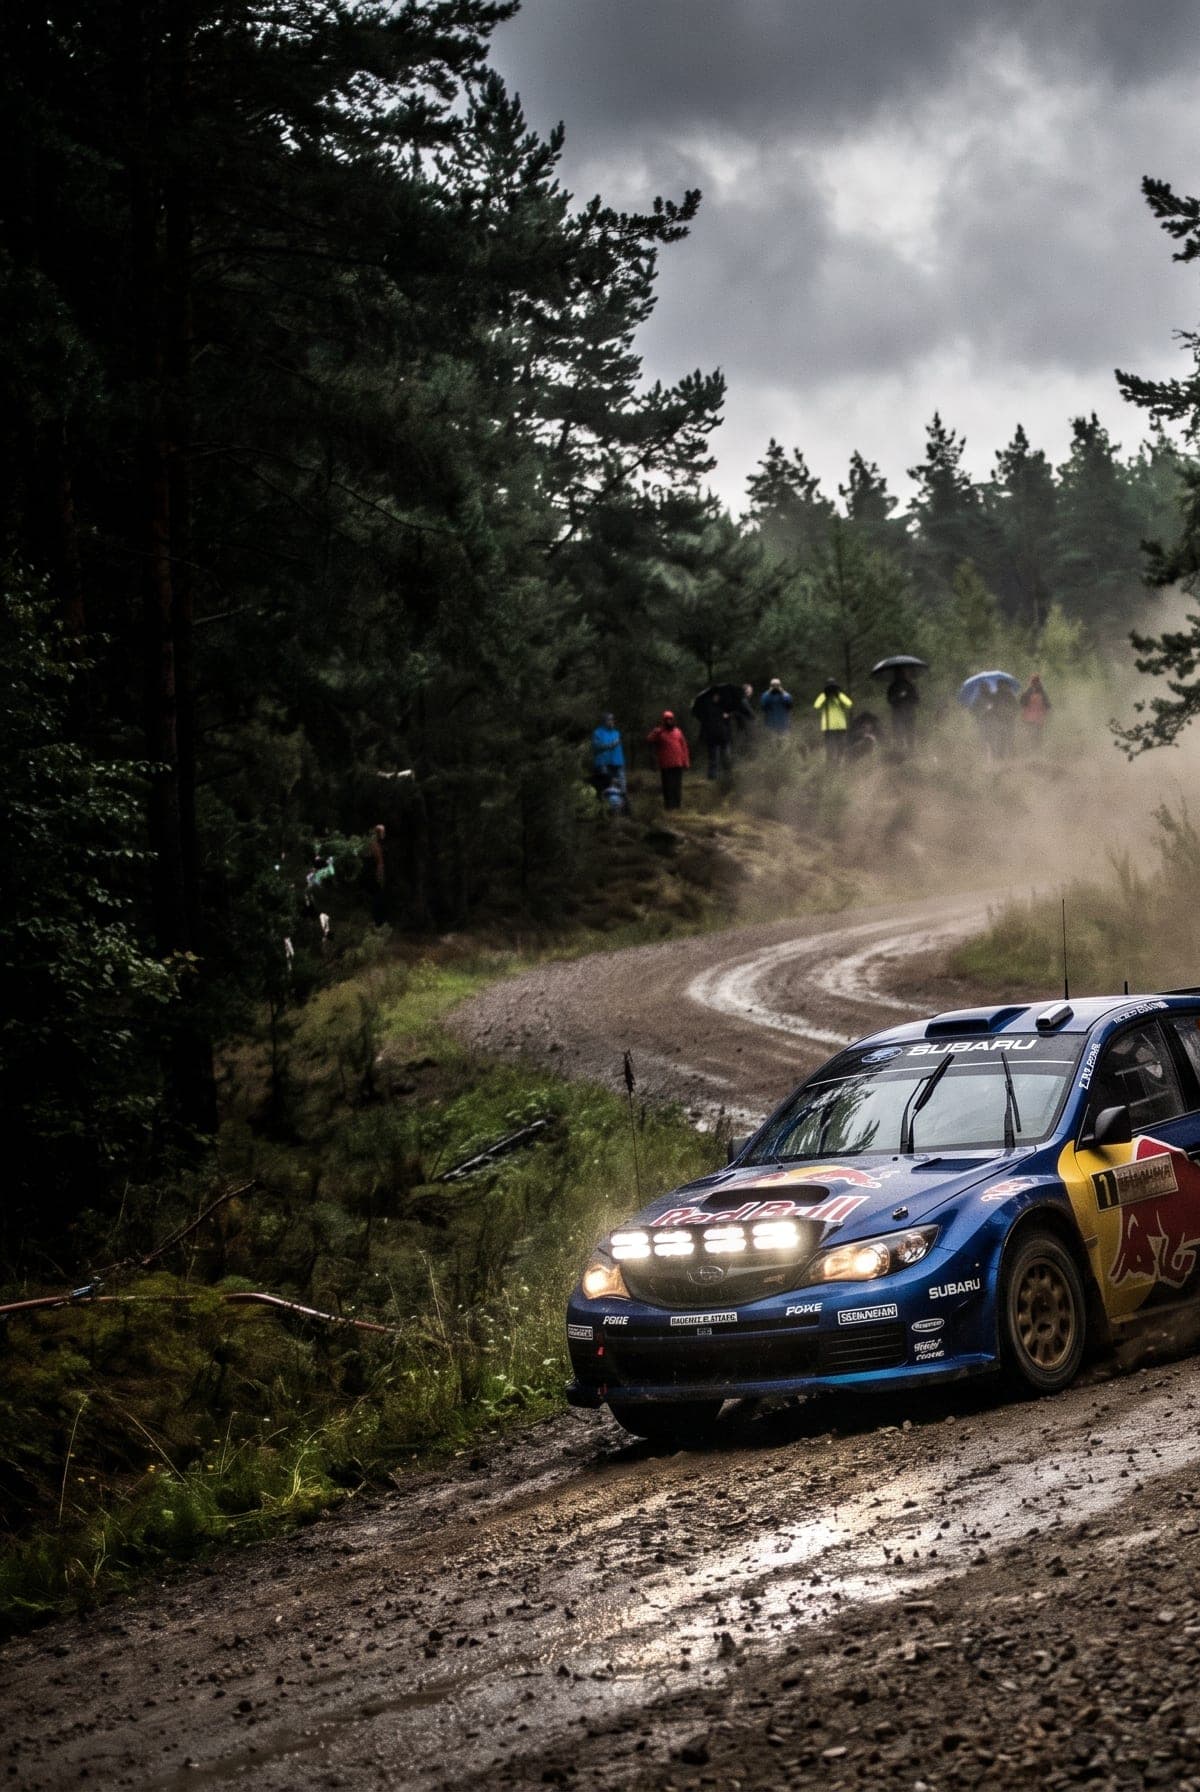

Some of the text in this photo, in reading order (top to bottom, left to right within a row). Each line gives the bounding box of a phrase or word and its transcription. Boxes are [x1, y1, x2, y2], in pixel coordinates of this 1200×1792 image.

[906, 1039, 1037, 1057] SUBARU
[1099, 1173, 1112, 1206] 1
[649, 1196, 871, 1227] Red Bull
[928, 1277, 981, 1300] SUBARU
